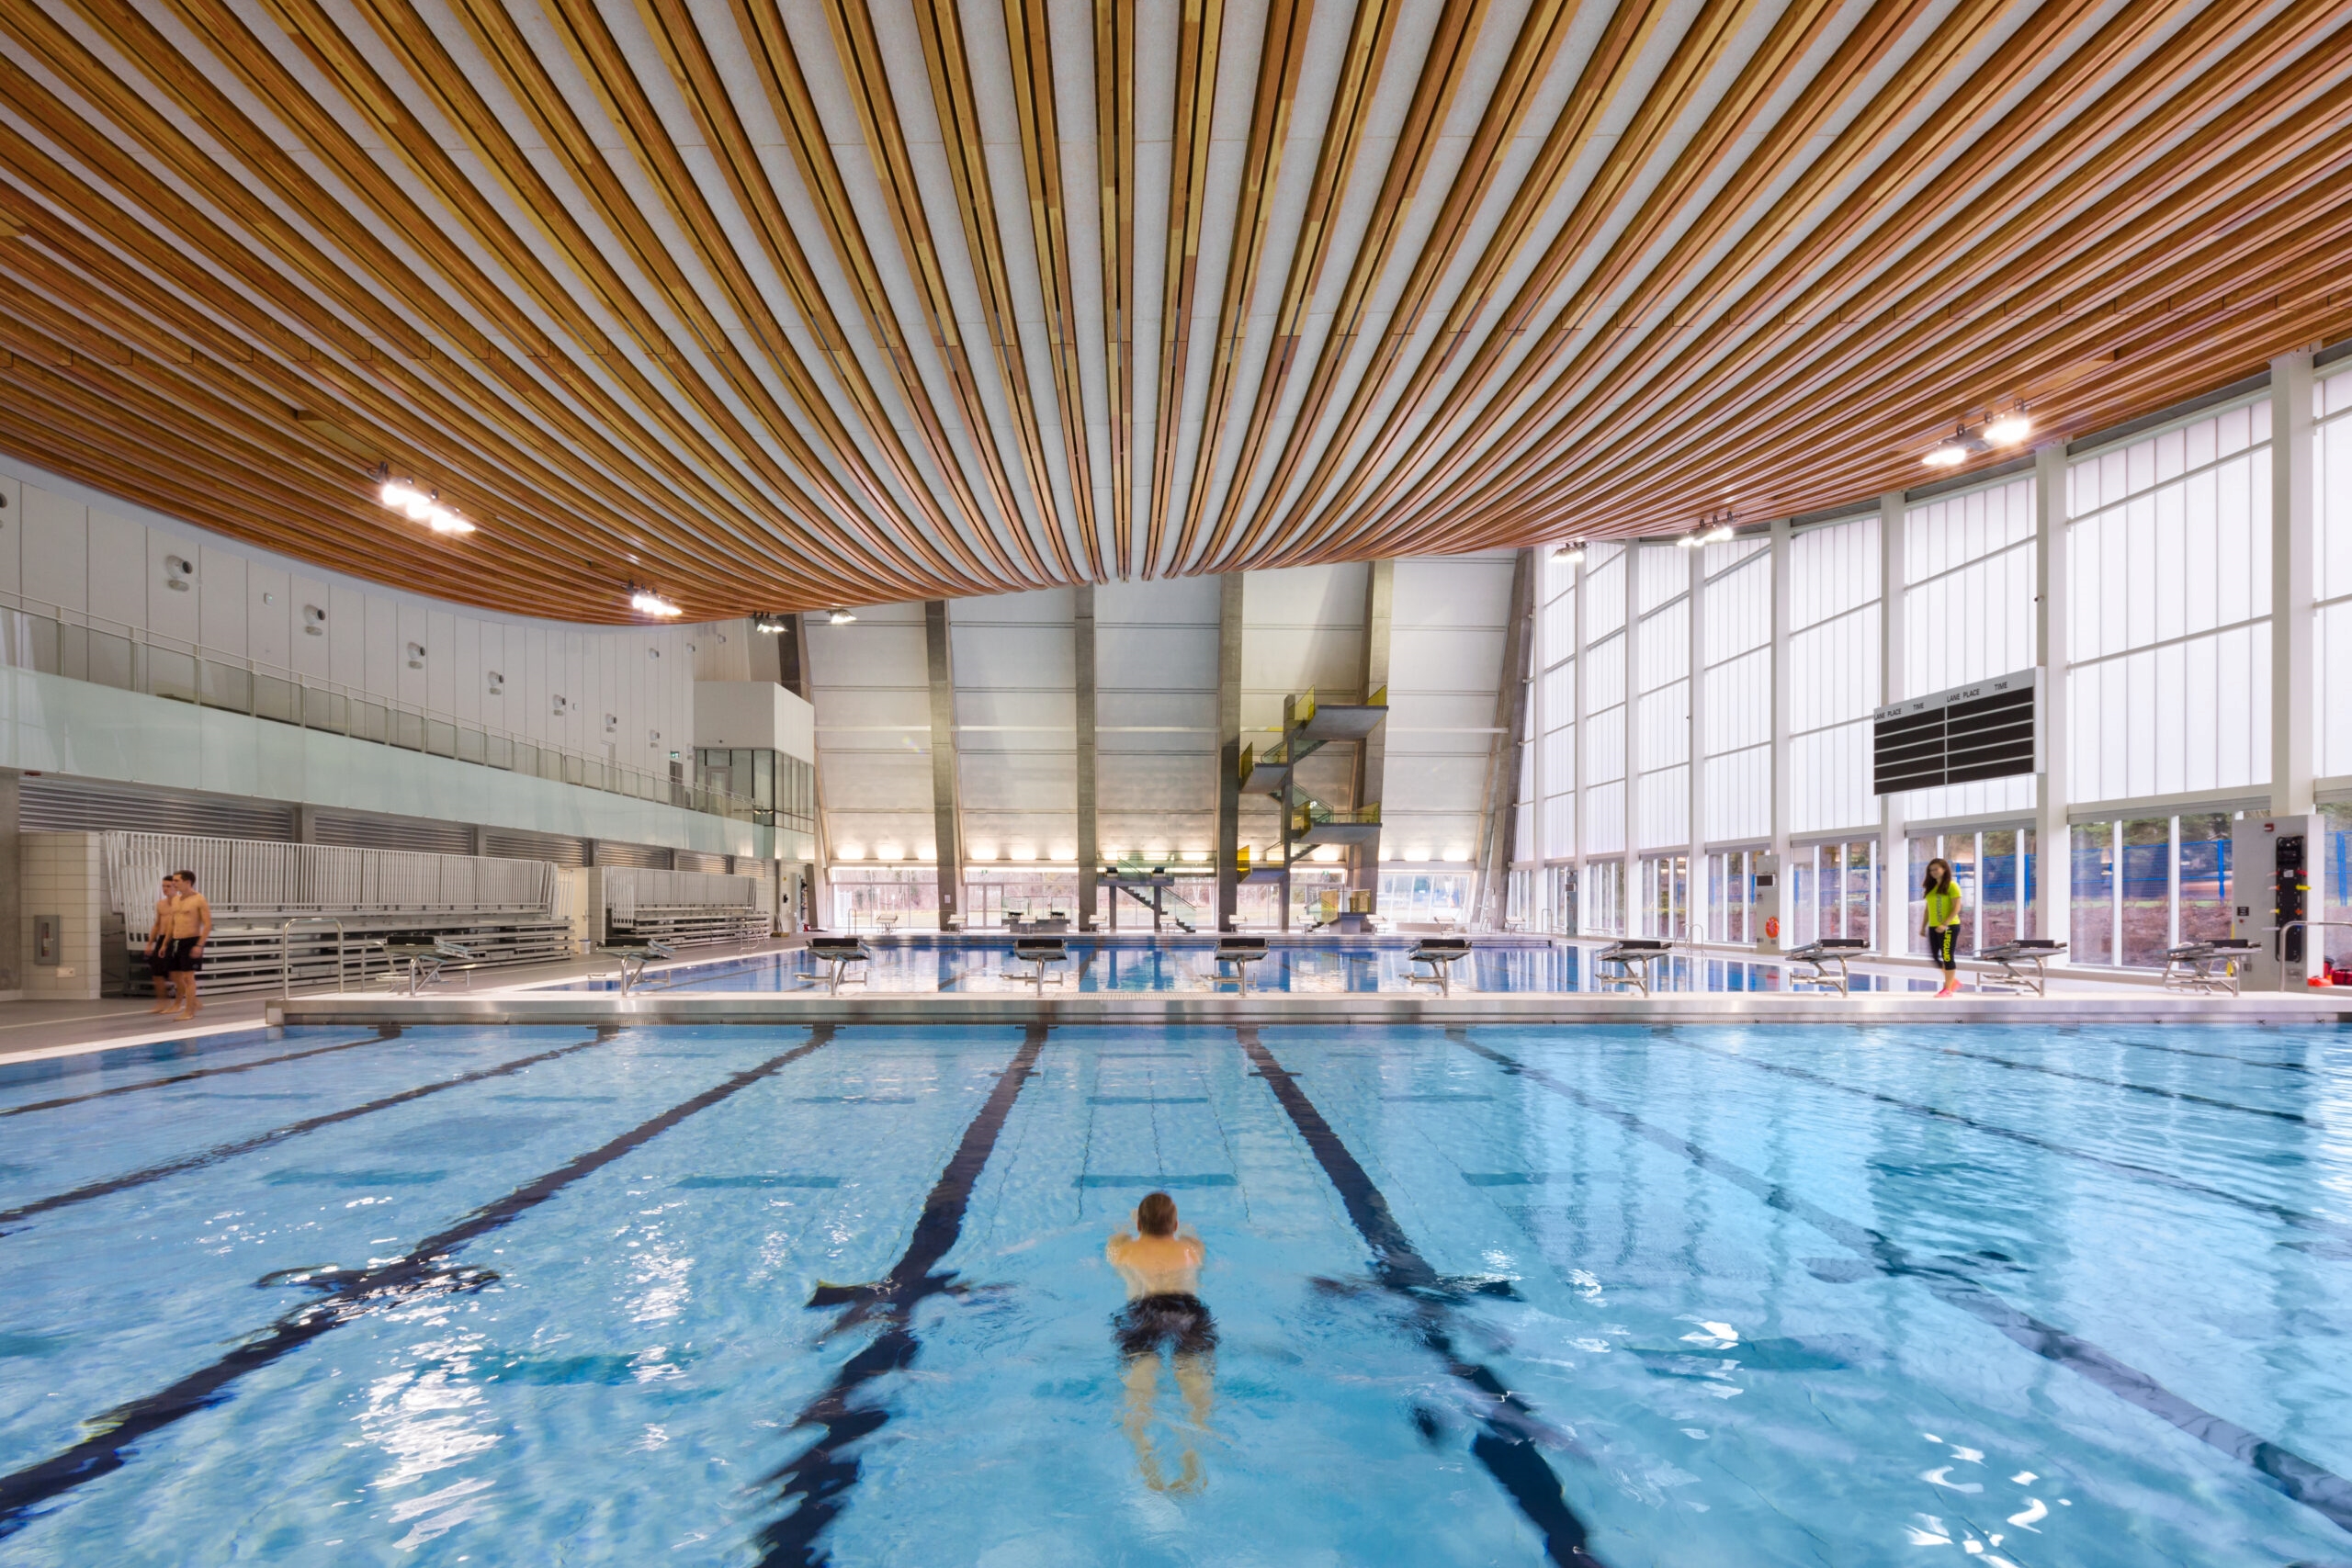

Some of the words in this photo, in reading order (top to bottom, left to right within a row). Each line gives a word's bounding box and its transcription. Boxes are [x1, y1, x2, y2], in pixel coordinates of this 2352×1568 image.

[1947, 694, 1960, 703] LANE
[1963, 689, 1980, 698] PLACE
[1995, 682, 2007, 691] TIME
[1887, 708, 1902, 716] PLACE
[1913, 703, 1924, 711] TIME
[1943, 930, 1952, 962] LIFEGUARD
